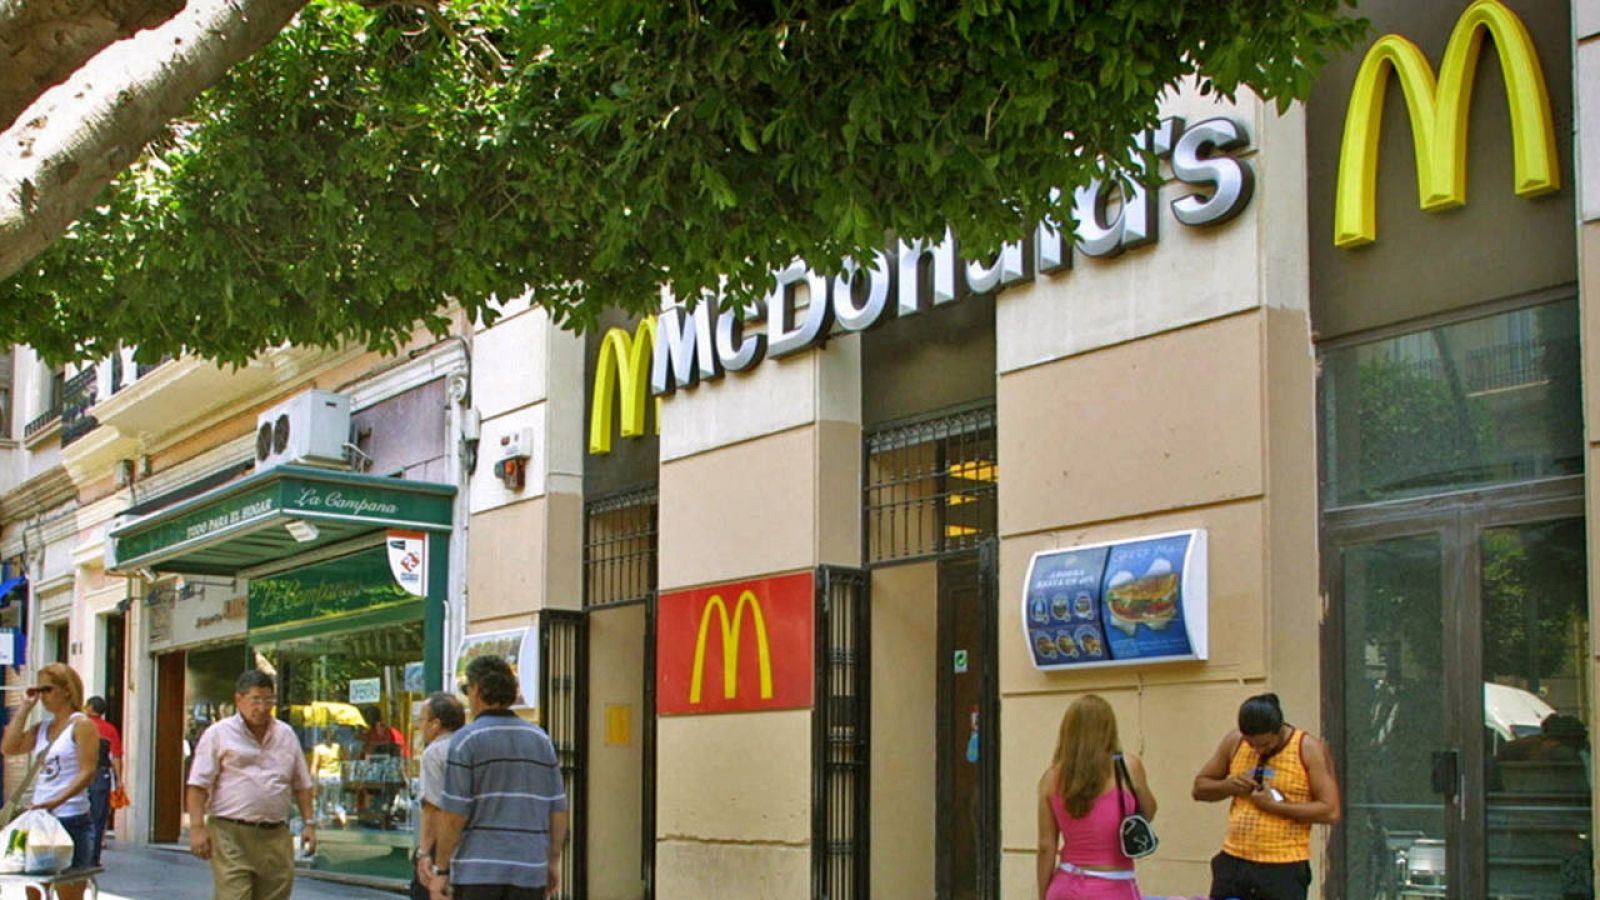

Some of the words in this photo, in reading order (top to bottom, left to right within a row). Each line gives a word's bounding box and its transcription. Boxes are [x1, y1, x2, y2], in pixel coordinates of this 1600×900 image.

[208, 514, 229, 531] PARA
[241, 498, 271, 518] HOGAR
[294, 487, 319, 507] La
[324, 491, 397, 515] Campana
